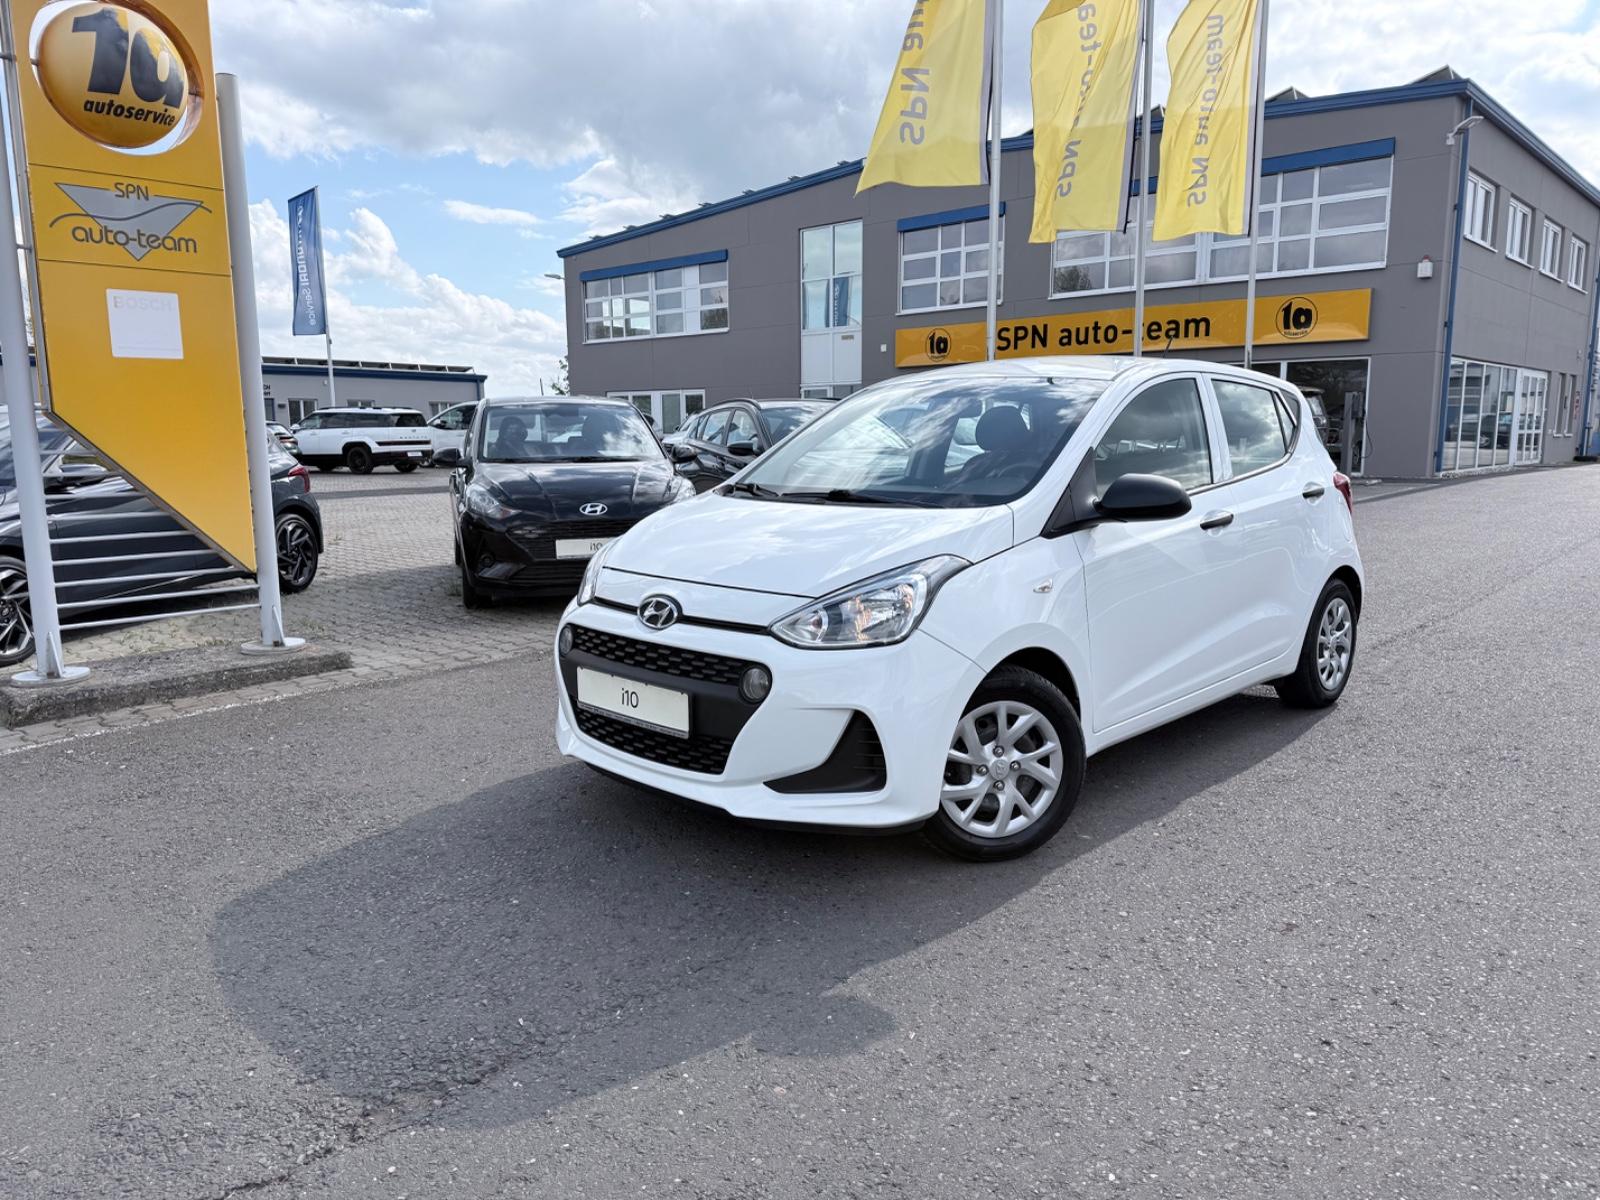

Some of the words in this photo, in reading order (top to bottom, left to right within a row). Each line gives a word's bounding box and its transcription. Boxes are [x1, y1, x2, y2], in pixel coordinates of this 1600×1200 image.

[84, 99, 176, 127] autoservice
[114, 182, 149, 201] SPN
[72, 225, 197, 253] auto-team
[113, 295, 173, 312] BOSCH
[1282, 301, 1312, 330] 1a
[997, 324, 1048, 350] SPN
[1059, 317, 1210, 346] auto-eam
[621, 688, 639, 708] i10
